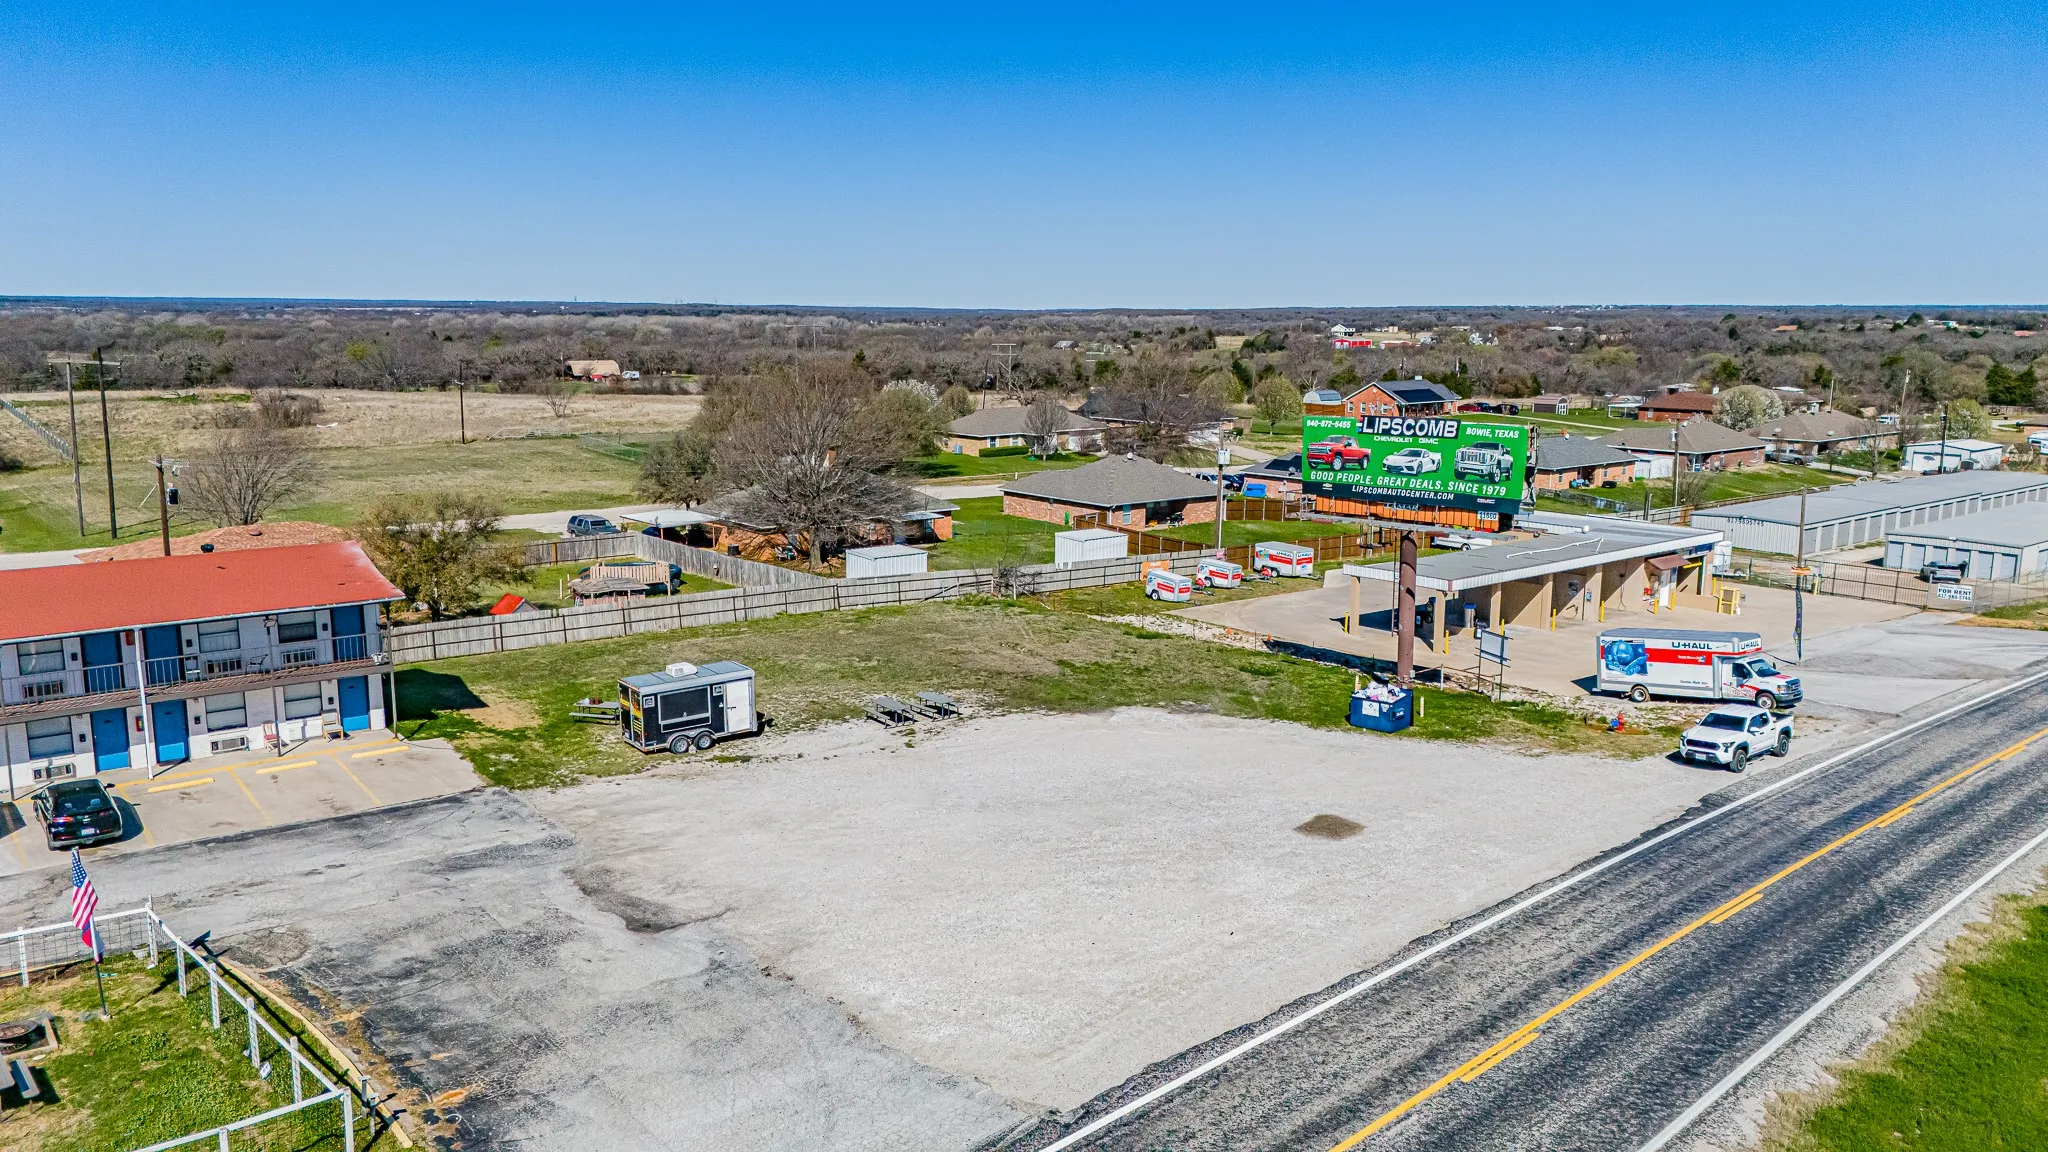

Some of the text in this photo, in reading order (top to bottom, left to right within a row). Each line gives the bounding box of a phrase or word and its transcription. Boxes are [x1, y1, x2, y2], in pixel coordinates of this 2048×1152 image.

[1362, 416, 1458, 437] LIPSCOMB
[1466, 426, 1520, 439] BOWIE, TEXAS
[1373, 435, 1439, 445] CHEVROLET GMC
[1310, 471, 1507, 496] GOOD PEOPLE. GREAT DEALS. SINCE 1979
[1352, 485, 1454, 500] LIPSCOMBAUTOCENTER.COM
[1671, 641, 1713, 650] U-HAUL
[1740, 640, 1760, 650] U-HAUL
